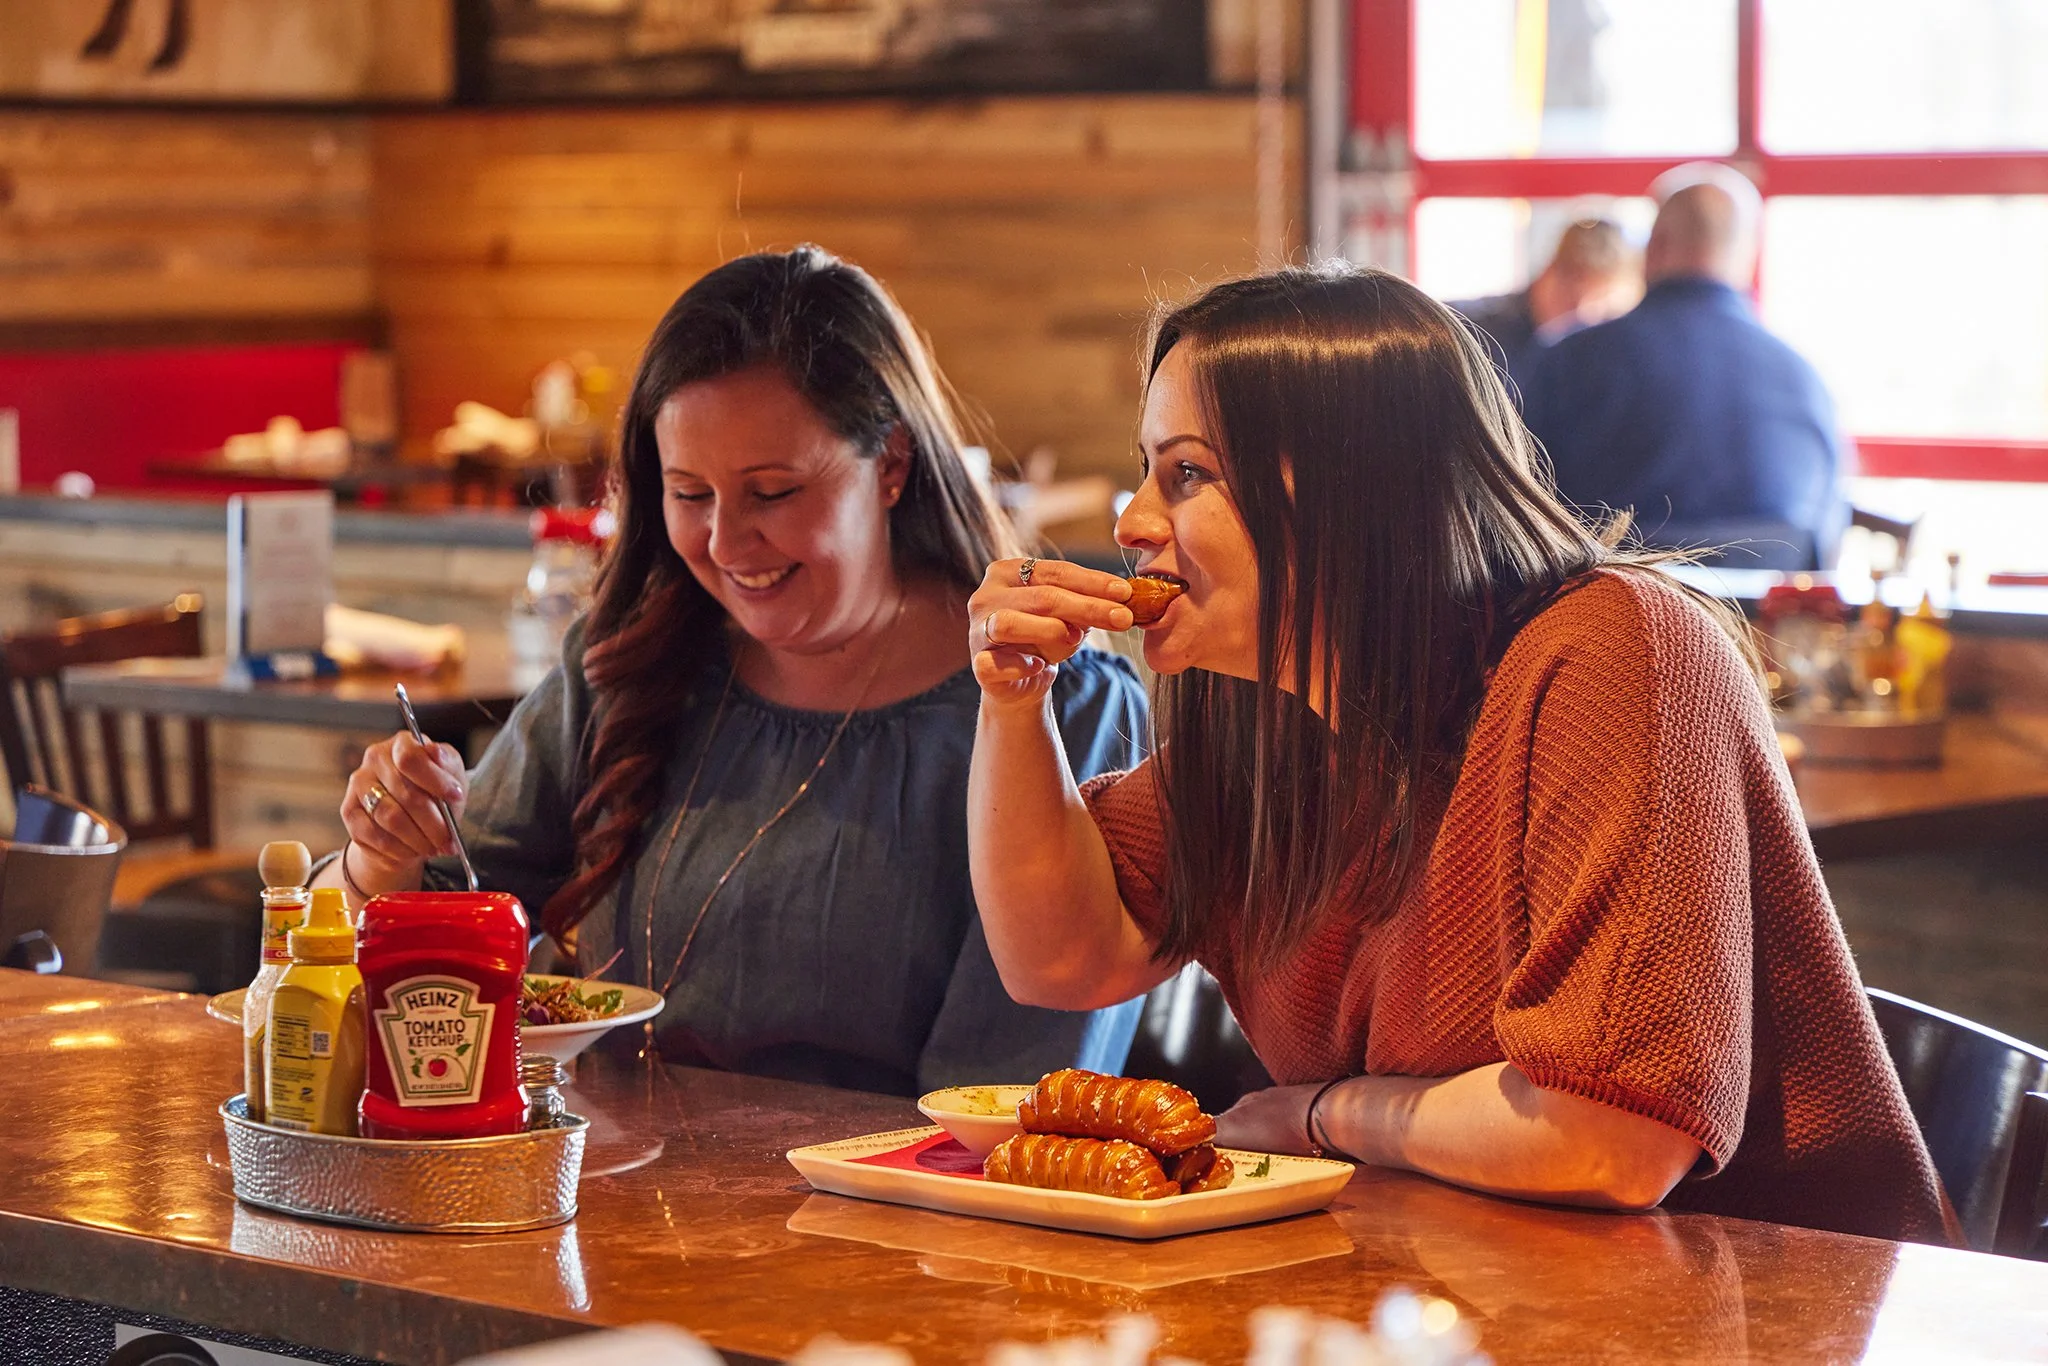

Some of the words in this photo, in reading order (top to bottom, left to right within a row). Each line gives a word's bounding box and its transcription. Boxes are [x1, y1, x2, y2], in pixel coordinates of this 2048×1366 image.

[405, 991, 459, 1010] HEINZ
[403, 1019, 465, 1035] TOMATO
[408, 1034, 464, 1048] KETCHUP
